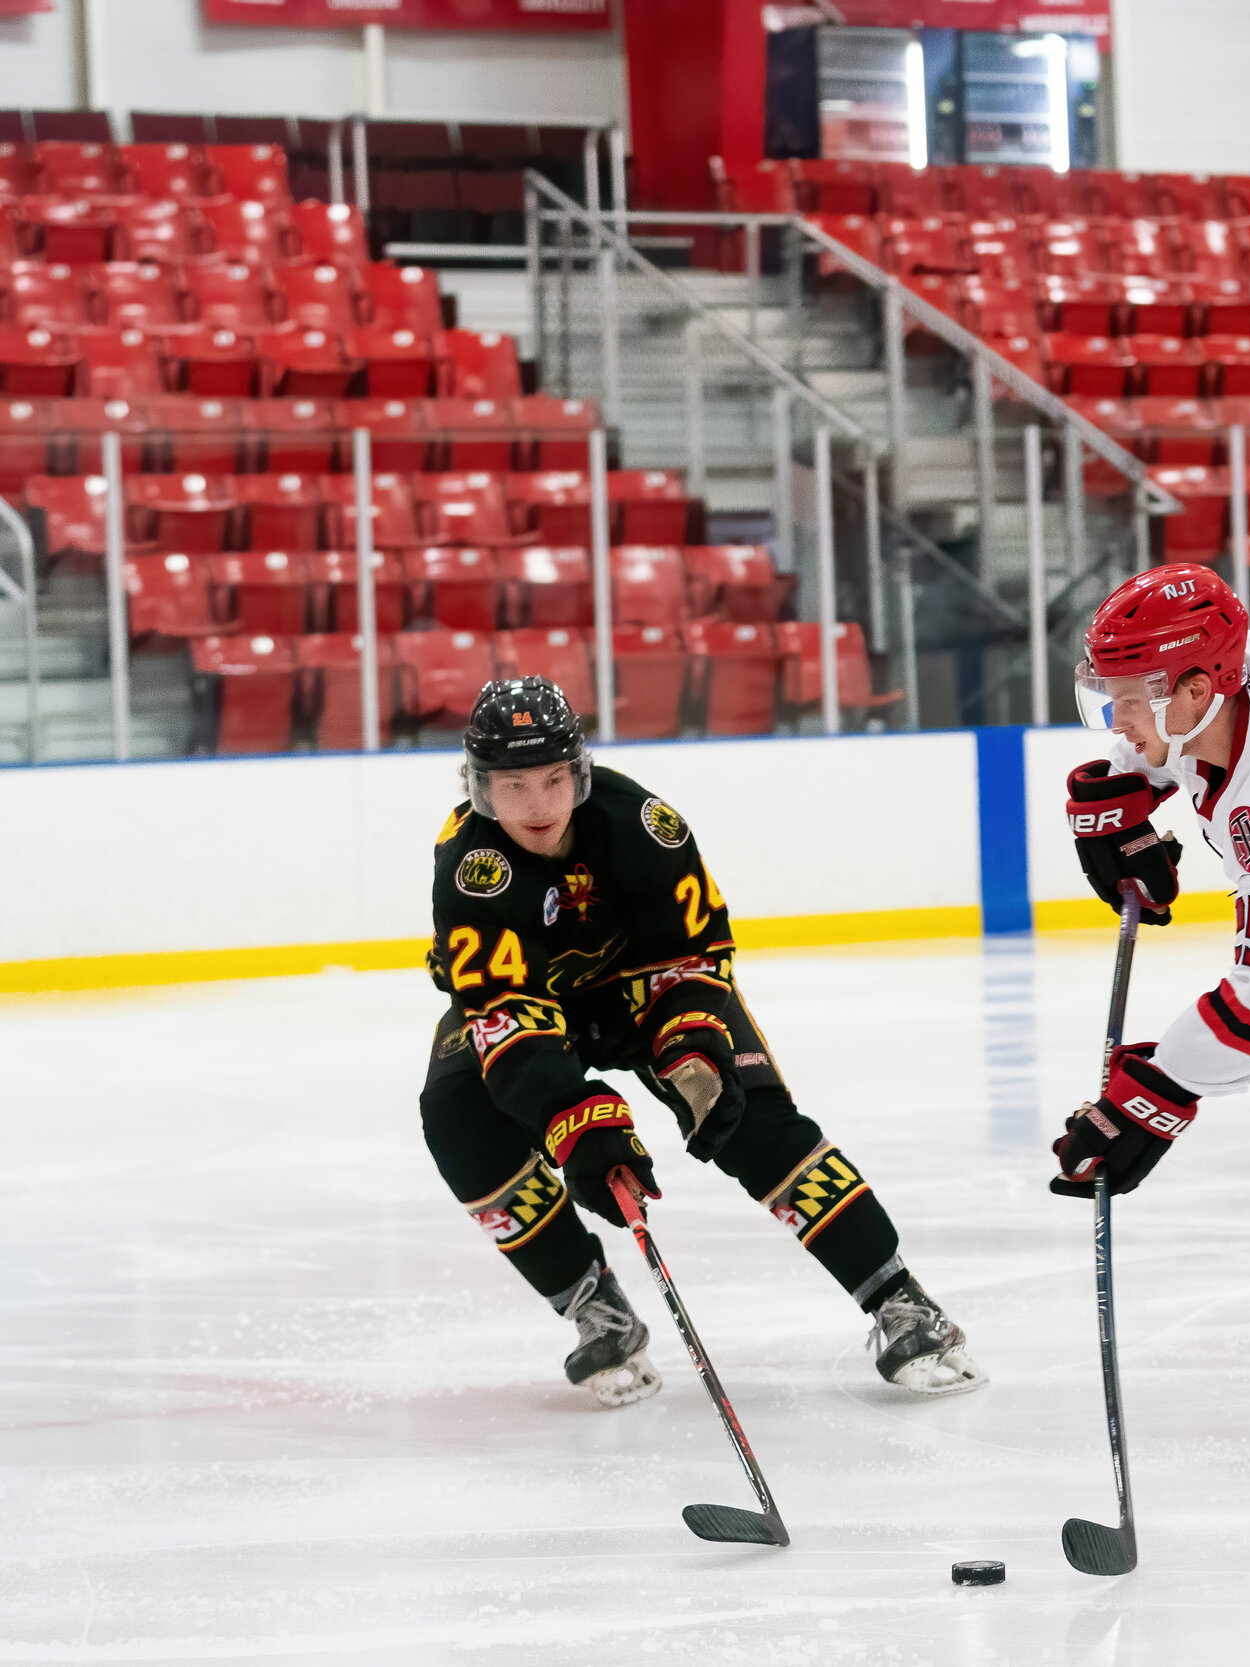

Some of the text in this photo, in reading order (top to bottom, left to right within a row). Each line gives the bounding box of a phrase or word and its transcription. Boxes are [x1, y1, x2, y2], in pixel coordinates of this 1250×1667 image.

[1163, 579, 1196, 600] NJT
[512, 711, 533, 727] 24
[447, 925, 528, 992] 24
